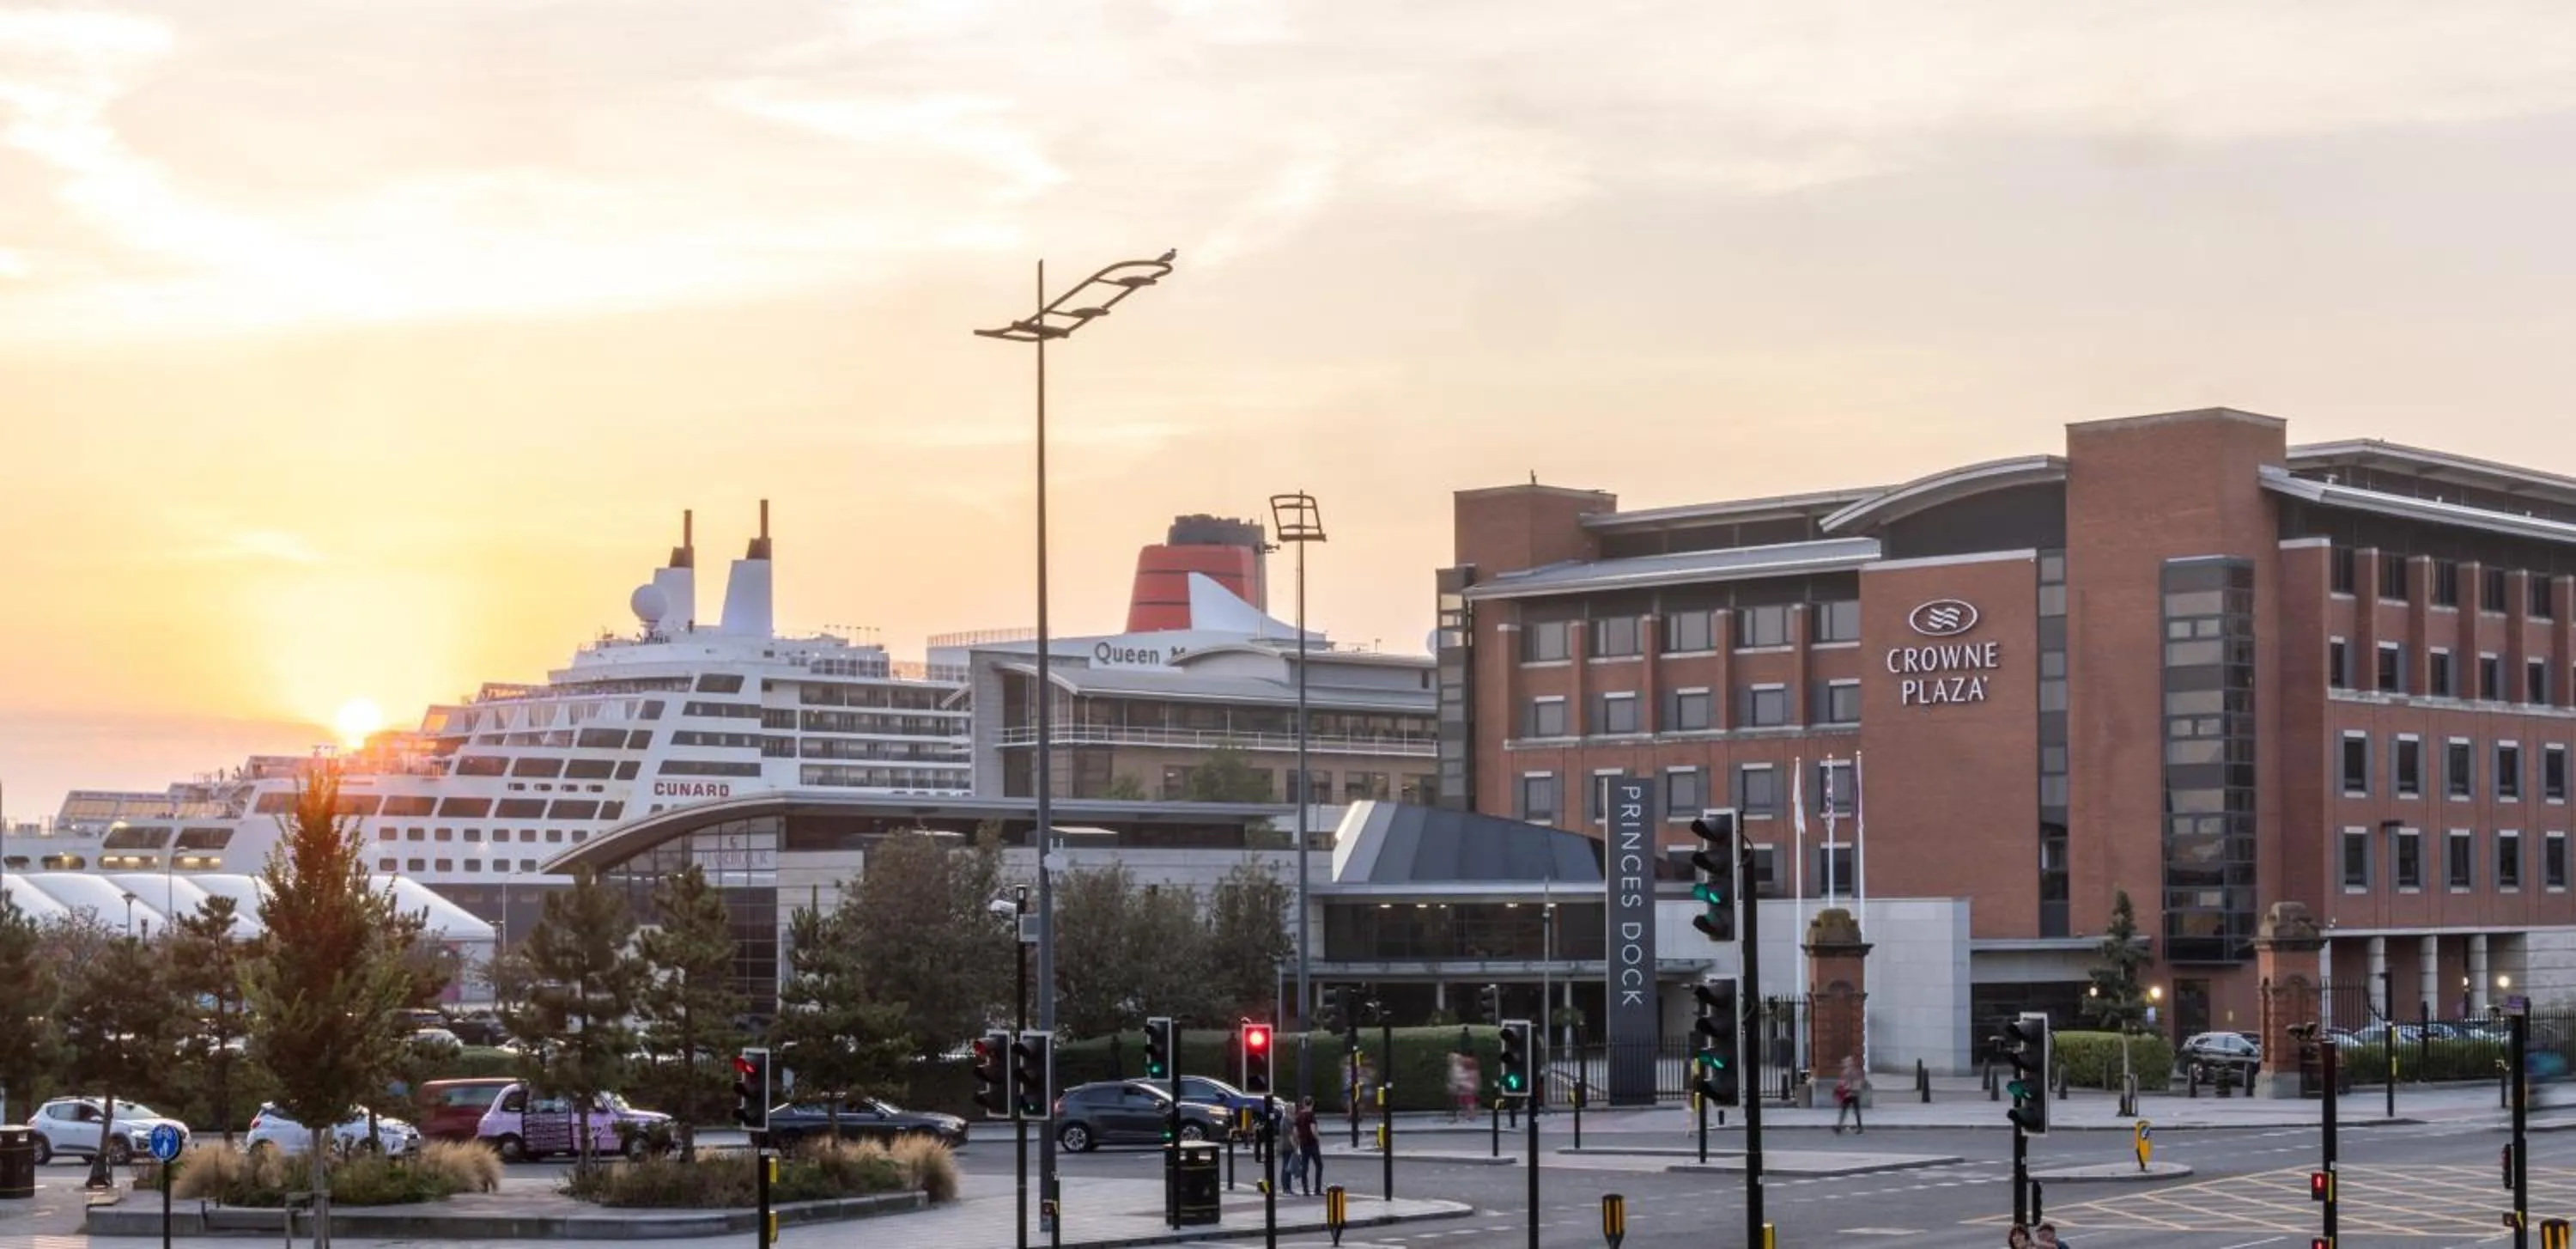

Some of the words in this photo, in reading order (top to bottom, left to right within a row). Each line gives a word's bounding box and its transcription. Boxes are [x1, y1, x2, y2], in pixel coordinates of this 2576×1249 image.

[1094, 641, 1159, 665] Queen
[1886, 641, 1998, 673] CROWNE
[1902, 676, 1986, 704] PLAZA
[653, 783, 729, 797] CUNARD
[1620, 786, 1642, 908] PRINCES
[1621, 922, 1643, 1007] DOCK
